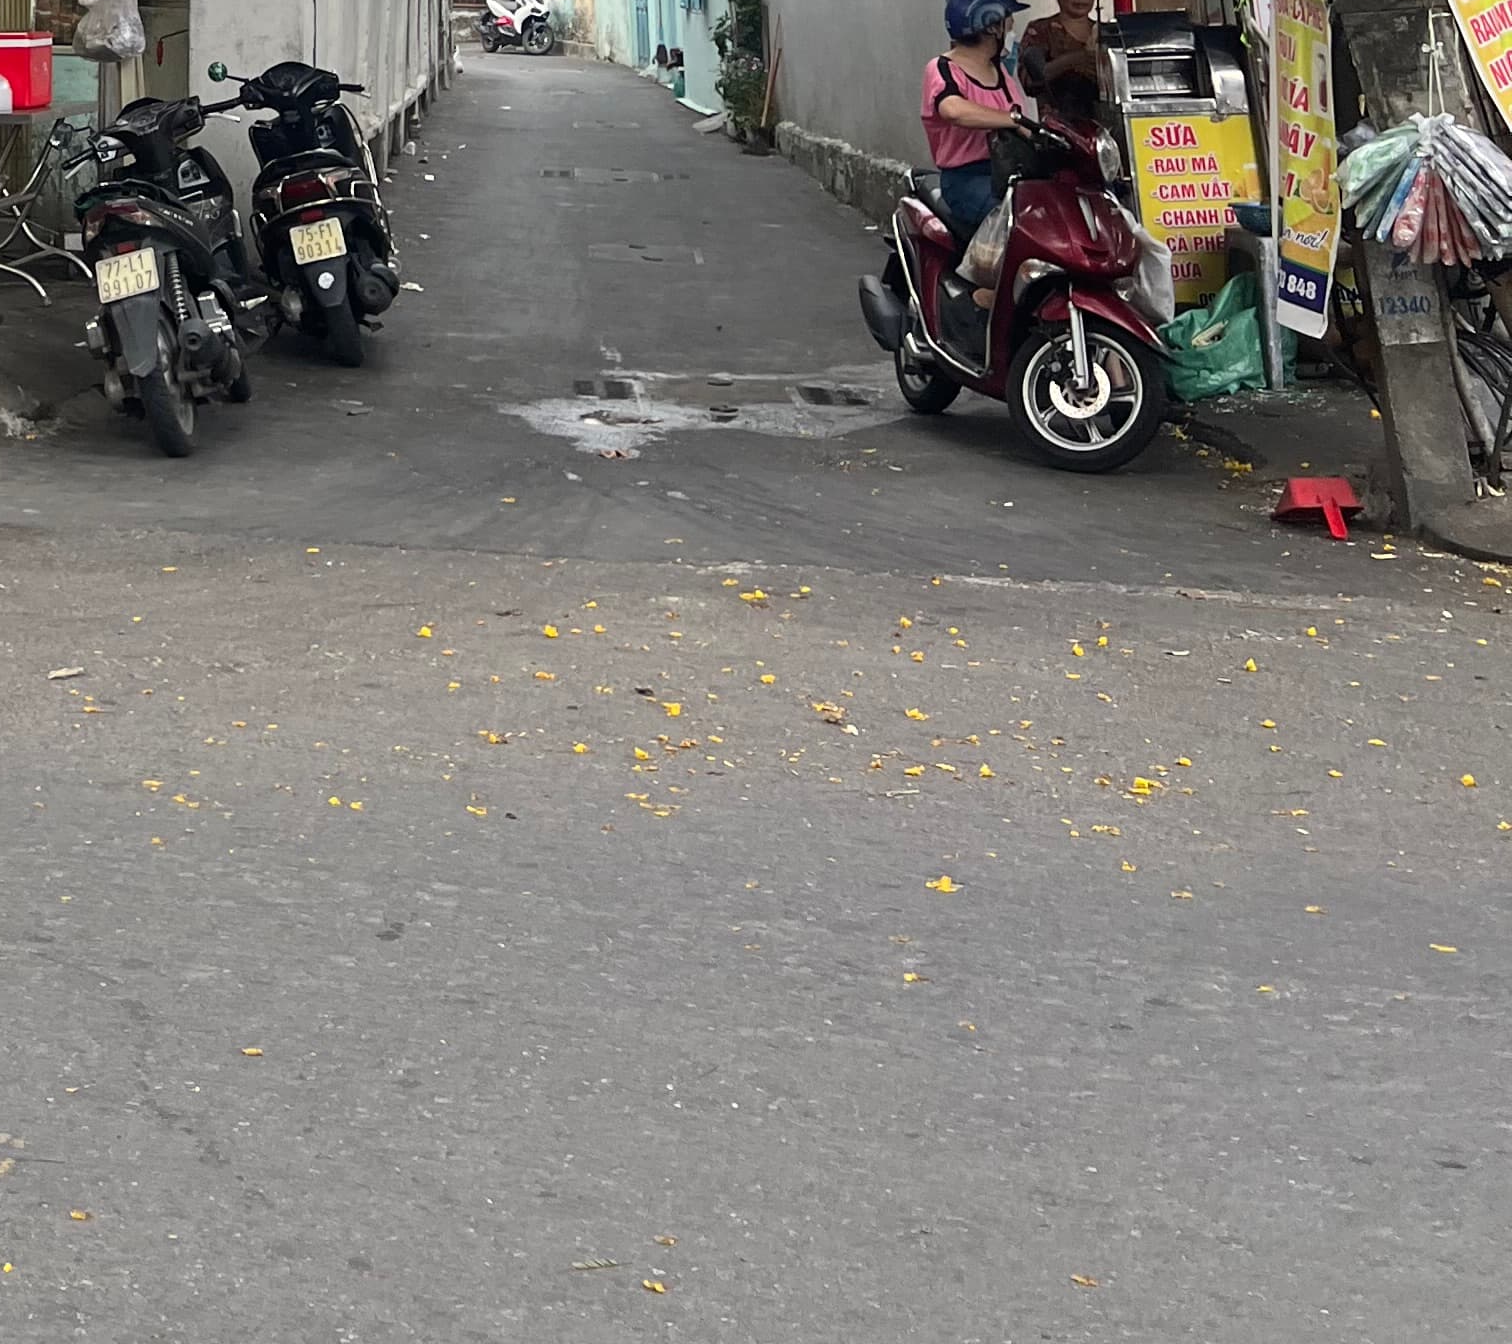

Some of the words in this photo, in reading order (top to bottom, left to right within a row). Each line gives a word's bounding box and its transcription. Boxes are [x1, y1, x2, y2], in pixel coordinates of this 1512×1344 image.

[1192, 153, 1218, 172] MÁ
[298, 223, 334, 243] 75-F1
[298, 238, 342, 261] 903.14
[105, 254, 145, 279] 77-L1
[103, 270, 152, 300] 991.07
[1287, 275, 1316, 300] 848
